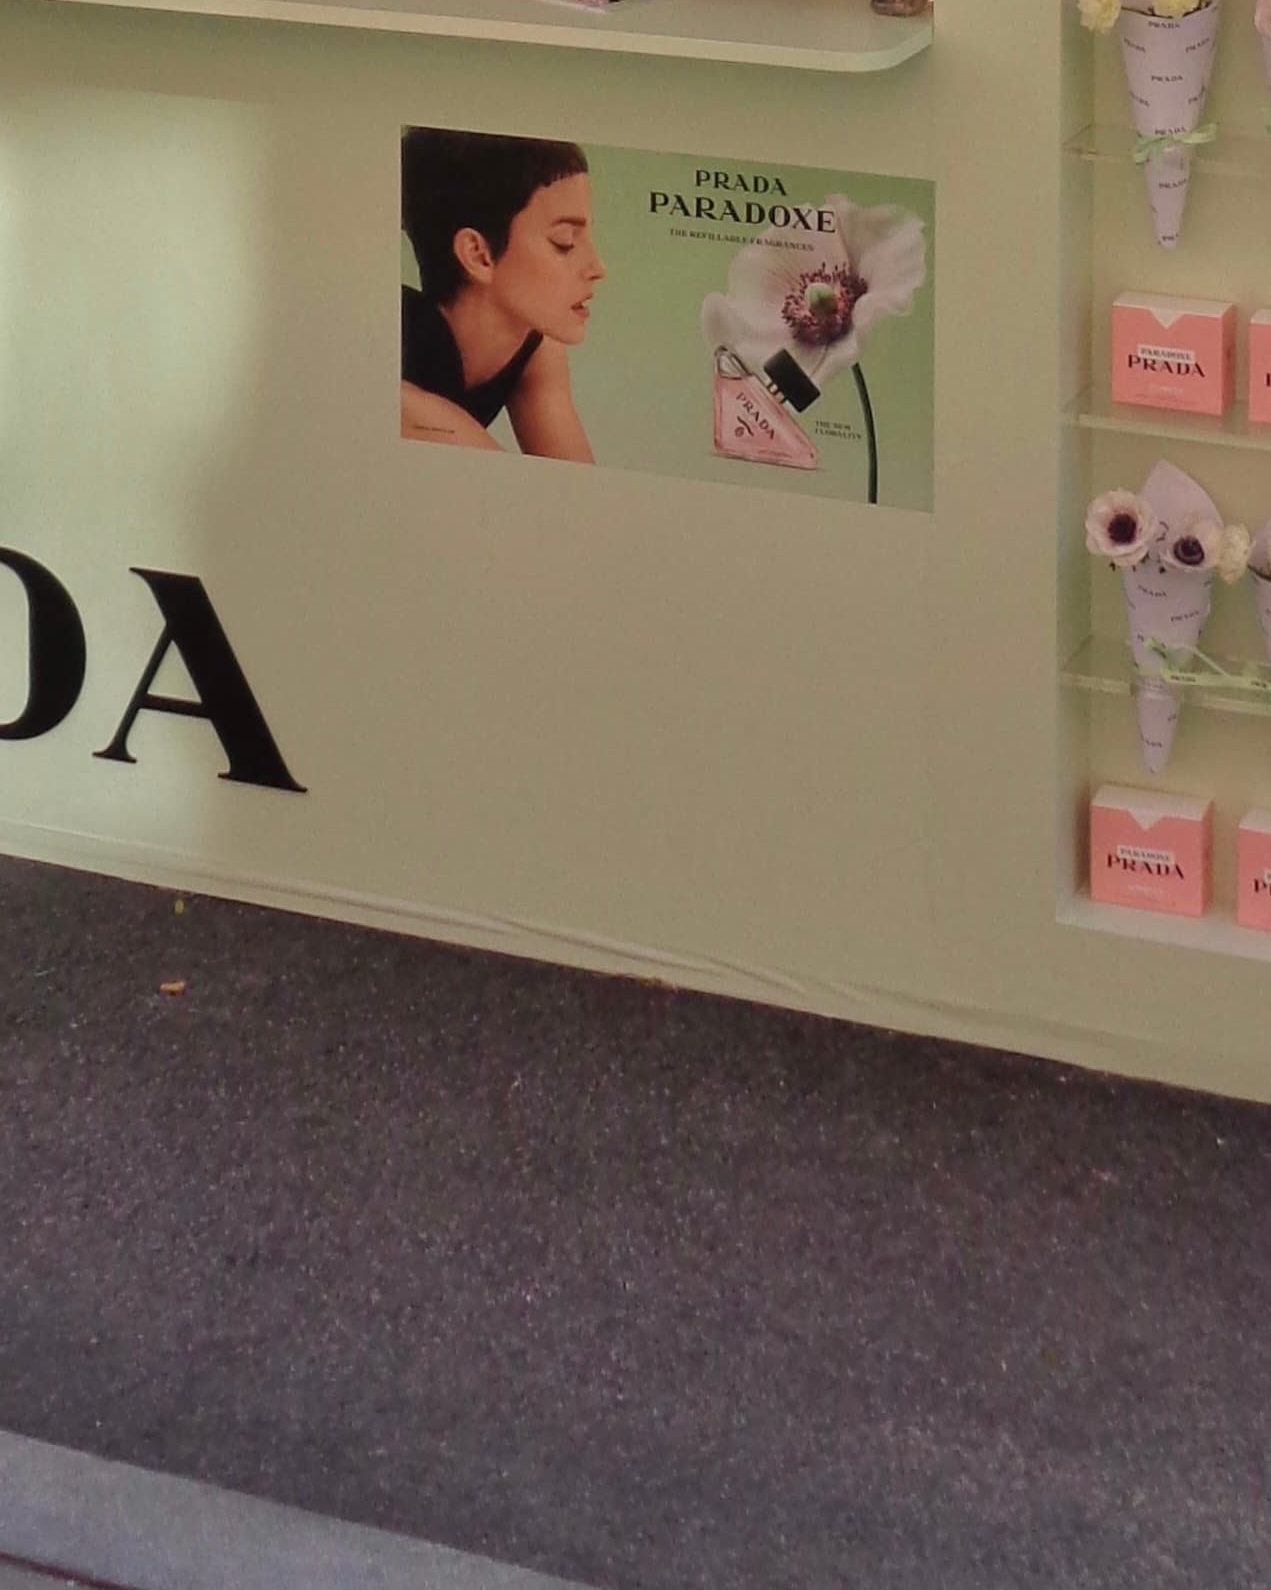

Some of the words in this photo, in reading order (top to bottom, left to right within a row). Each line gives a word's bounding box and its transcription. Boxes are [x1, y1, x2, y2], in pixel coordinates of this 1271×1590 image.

[1151, 75, 1183, 83] PRADA
[696, 170, 787, 196] PRADA
[650, 191, 836, 234] PARADOXE
[670, 229, 687, 238] THE
[1128, 354, 1206, 378] PRADA
[736, 393, 776, 439] PRADA
[1108, 854, 1185, 879] PRADA
